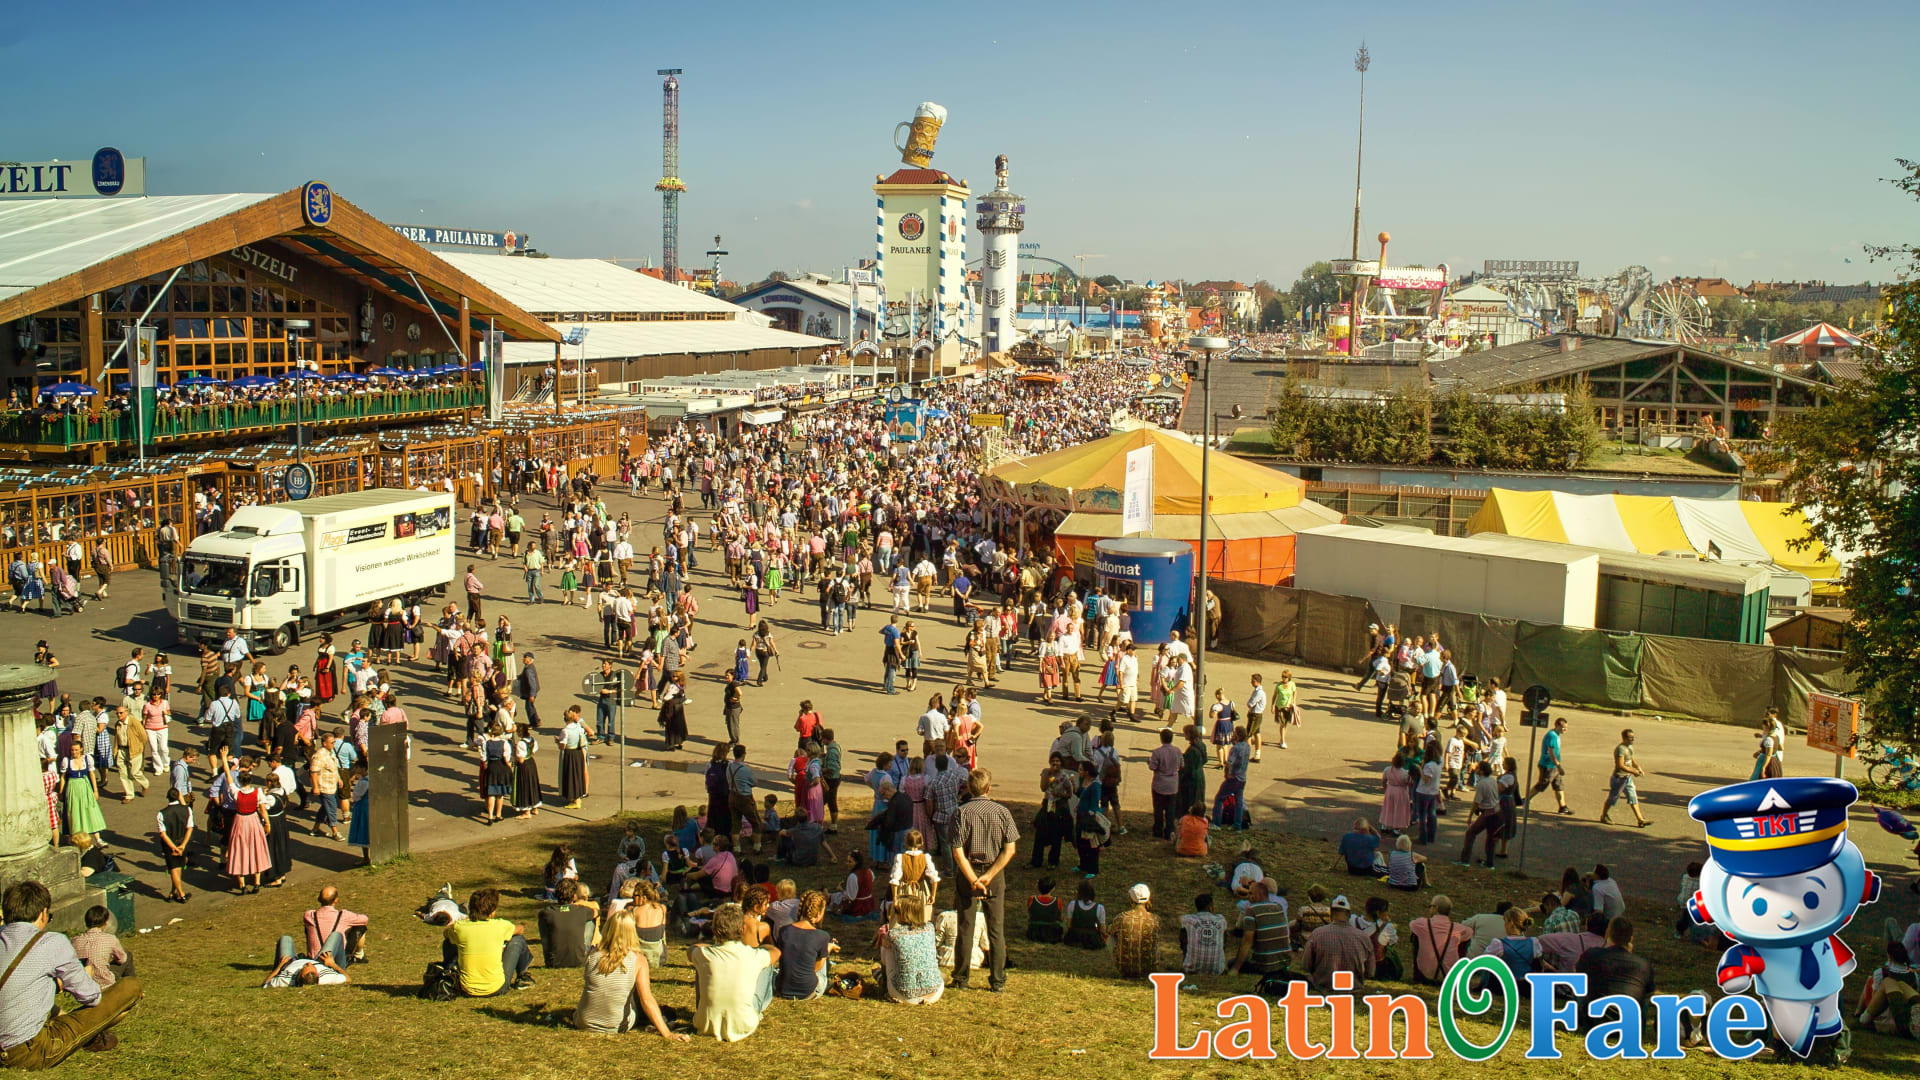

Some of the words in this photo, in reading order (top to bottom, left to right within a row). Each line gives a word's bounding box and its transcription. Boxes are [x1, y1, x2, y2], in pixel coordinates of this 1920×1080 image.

[0, 165, 72, 193] ELT
[435, 229, 499, 247] PAULANER.
[890, 246, 932, 254] PAULANER
[293, 476, 303, 485] HB
[320, 532, 347, 551] Magic
[355, 560, 383, 573] Visionen
[384, 555, 406, 566] werden
[407, 547, 441, 560] Wirklichkeit!
[1096, 561, 1140, 576] automat
